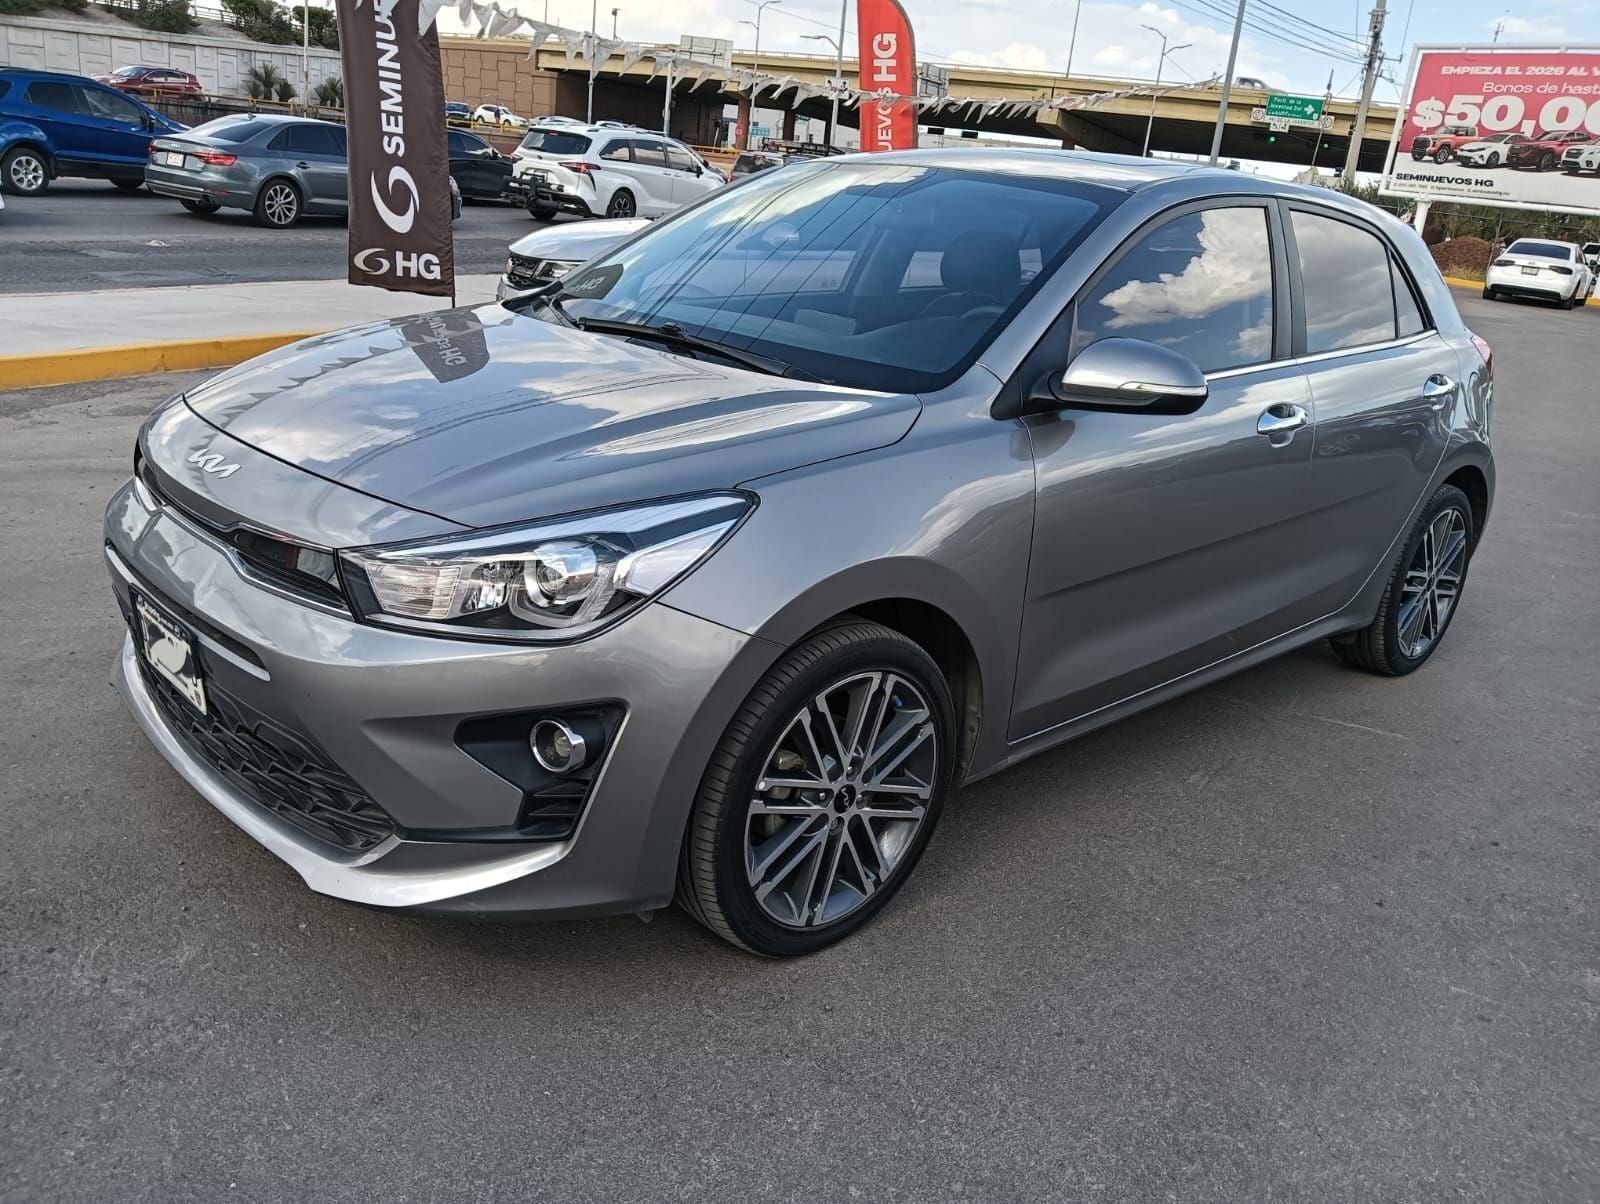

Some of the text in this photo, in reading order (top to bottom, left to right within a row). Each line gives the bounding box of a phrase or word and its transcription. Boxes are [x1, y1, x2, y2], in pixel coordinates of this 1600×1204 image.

[872, 33, 897, 82] HG
[1441, 66, 1502, 75] EMPIEZA
[1505, 66, 1522, 75] EL
[1525, 66, 1564, 75] 2026
[1566, 67, 1588, 76] AL
[373, 0, 405, 157] SEMINU
[1482, 82, 1533, 93] Bonos
[1536, 83, 1558, 94] de
[1395, 173, 1472, 186] SEMINUEVOS
[1474, 179, 1494, 188] HG
[395, 250, 441, 280] HG
[187, 448, 241, 479] KIA
